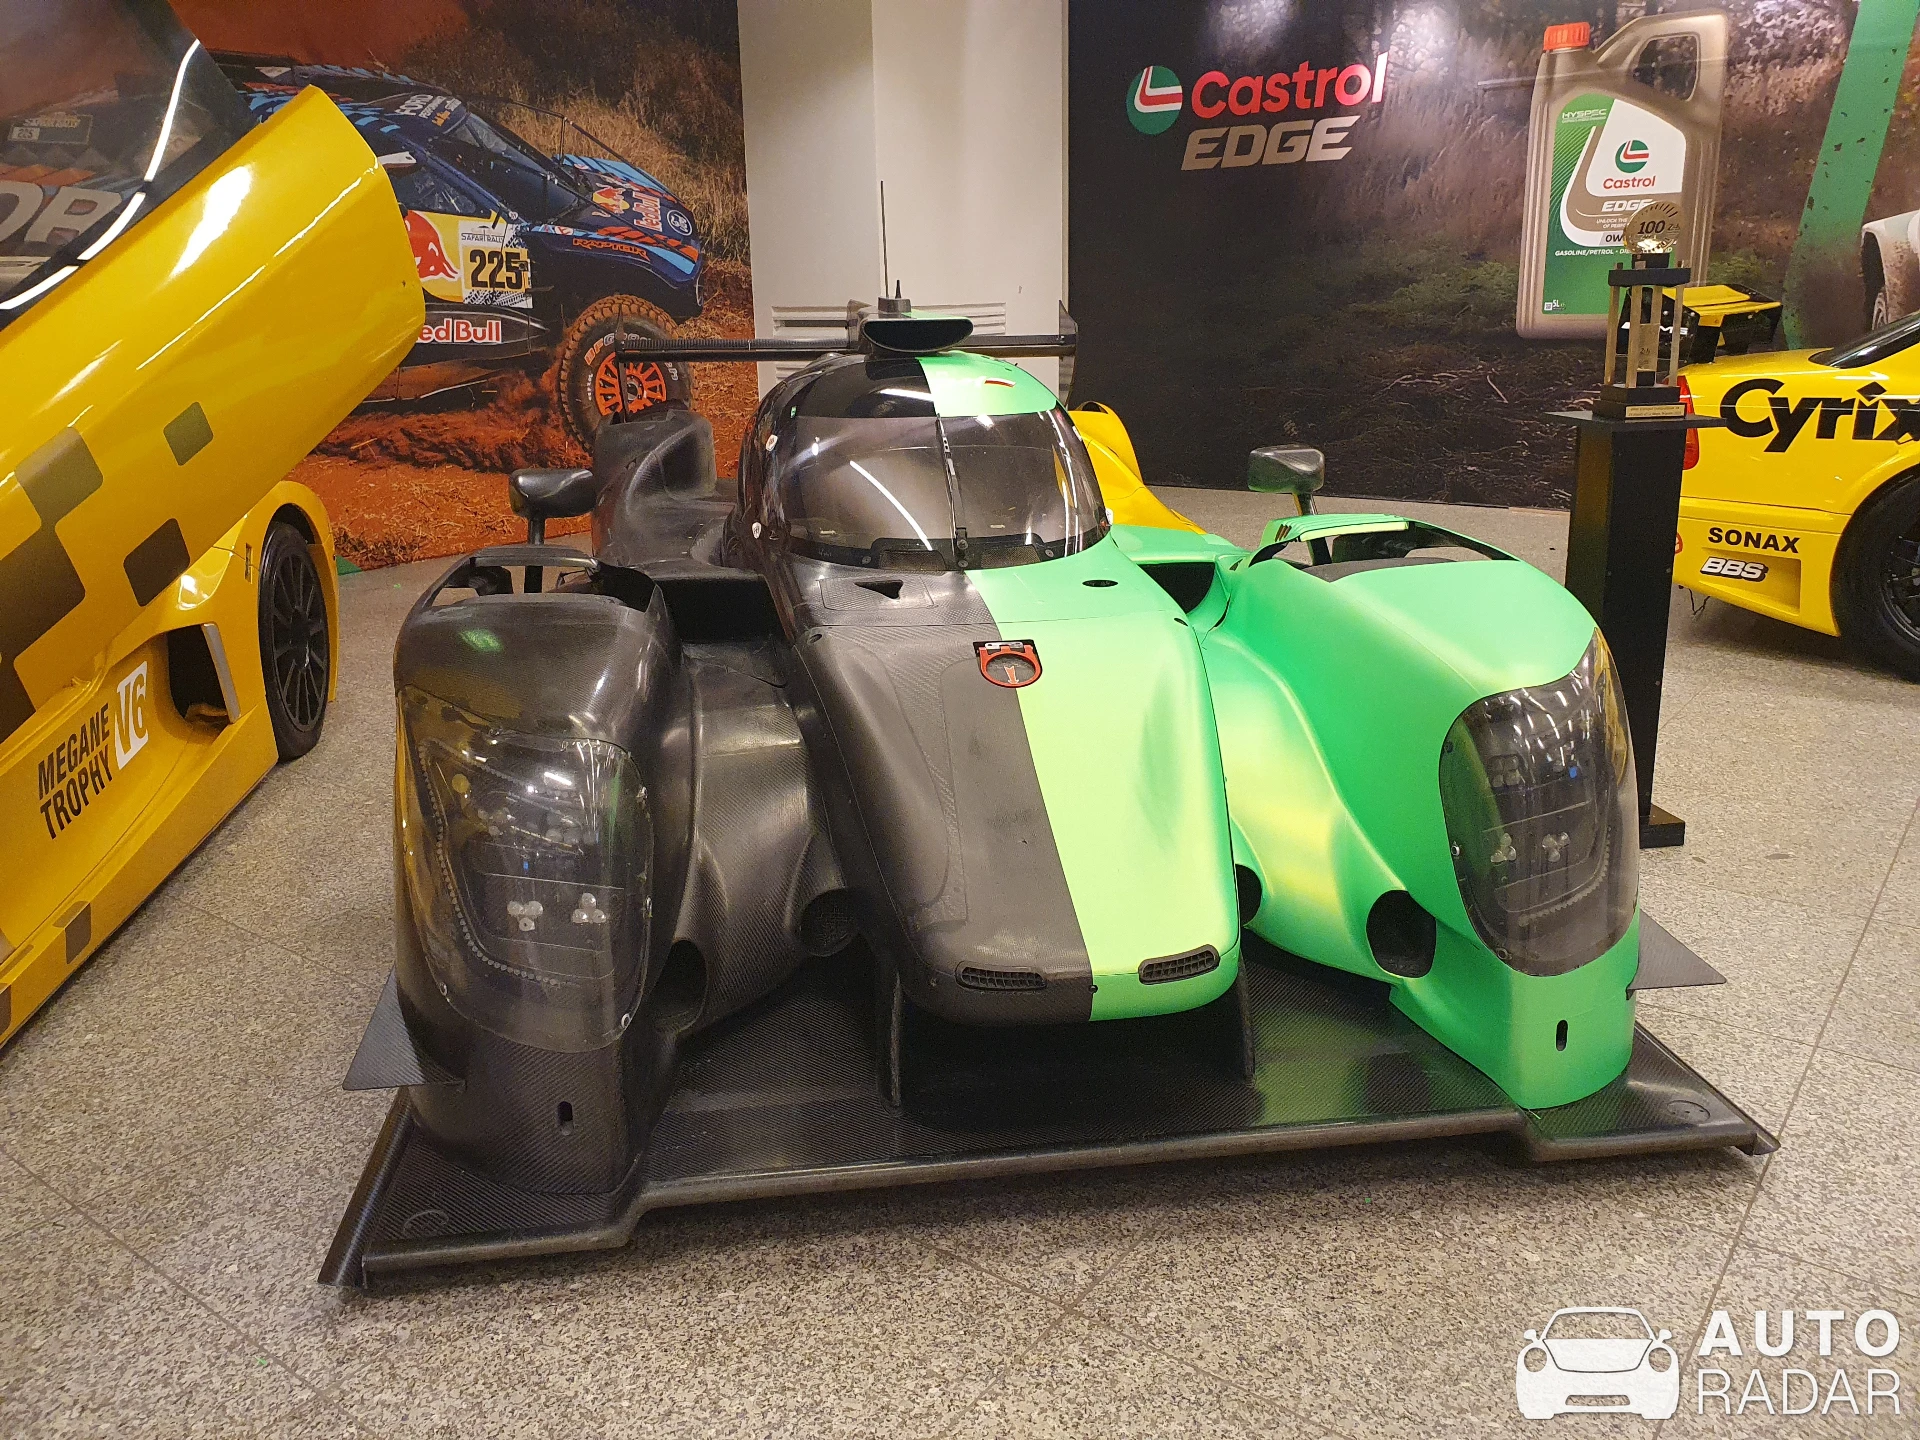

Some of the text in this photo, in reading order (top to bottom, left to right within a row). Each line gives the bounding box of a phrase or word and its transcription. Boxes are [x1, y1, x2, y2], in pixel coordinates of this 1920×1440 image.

[1191, 51, 1389, 119] Castrol
[1562, 108, 1607, 119] HYSPEC
[1180, 115, 1361, 171] EDGE
[1603, 175, 1656, 190] Castrol
[1637, 219, 1666, 235] 100
[469, 248, 523, 290] 225
[417, 318, 502, 343] ed Bull
[1719, 378, 1920, 453] Cyrix
[1707, 527, 1800, 553] SONAX
[1699, 556, 1768, 582] BBS
[114, 672, 148, 756] V6
[37, 702, 110, 800] MEGANE
[39, 744, 113, 840] TROPHY
